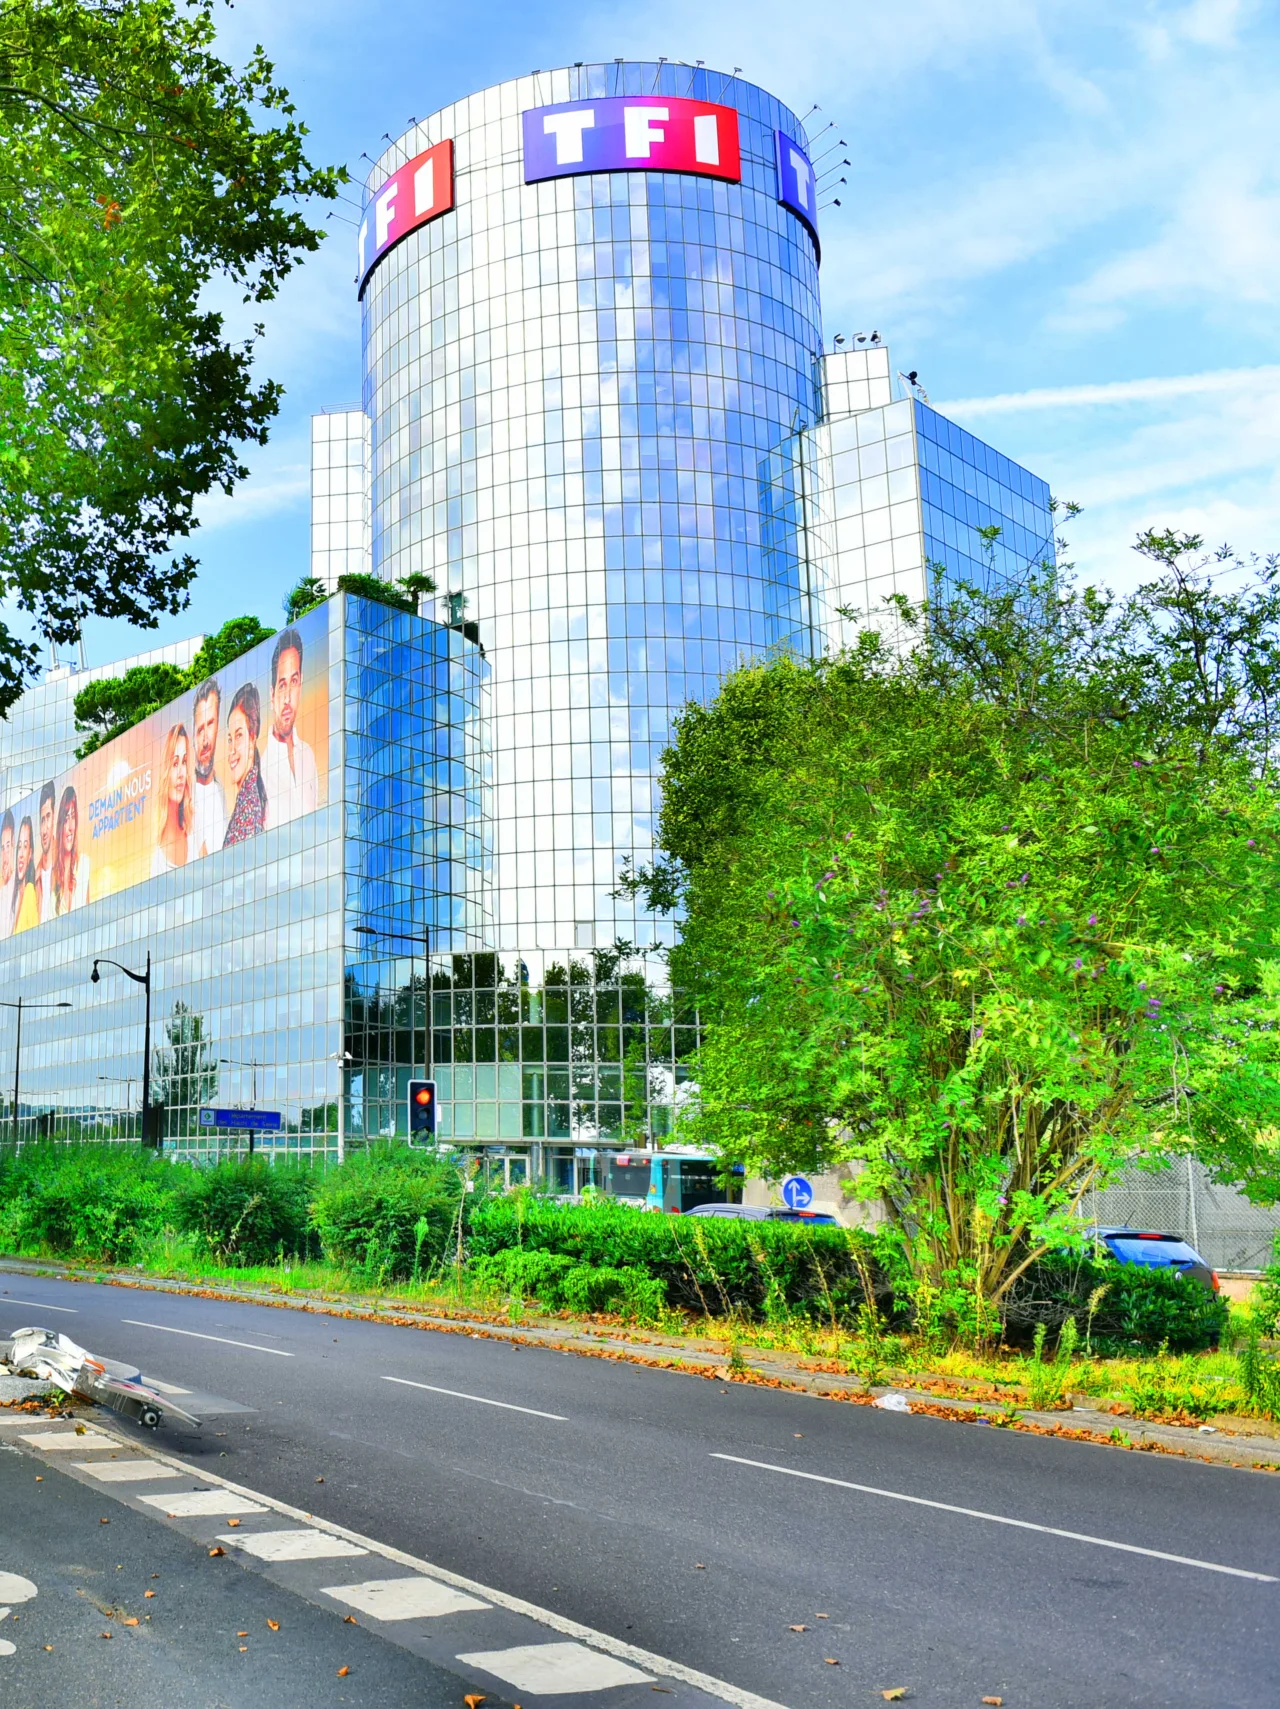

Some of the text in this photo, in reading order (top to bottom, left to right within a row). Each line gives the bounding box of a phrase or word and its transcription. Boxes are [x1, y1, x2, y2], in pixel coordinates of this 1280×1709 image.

[544, 107, 719, 165] TF1
[89, 769, 152, 821] DEMAIN NOUS
[92, 795, 147, 840] APPARTIENT
